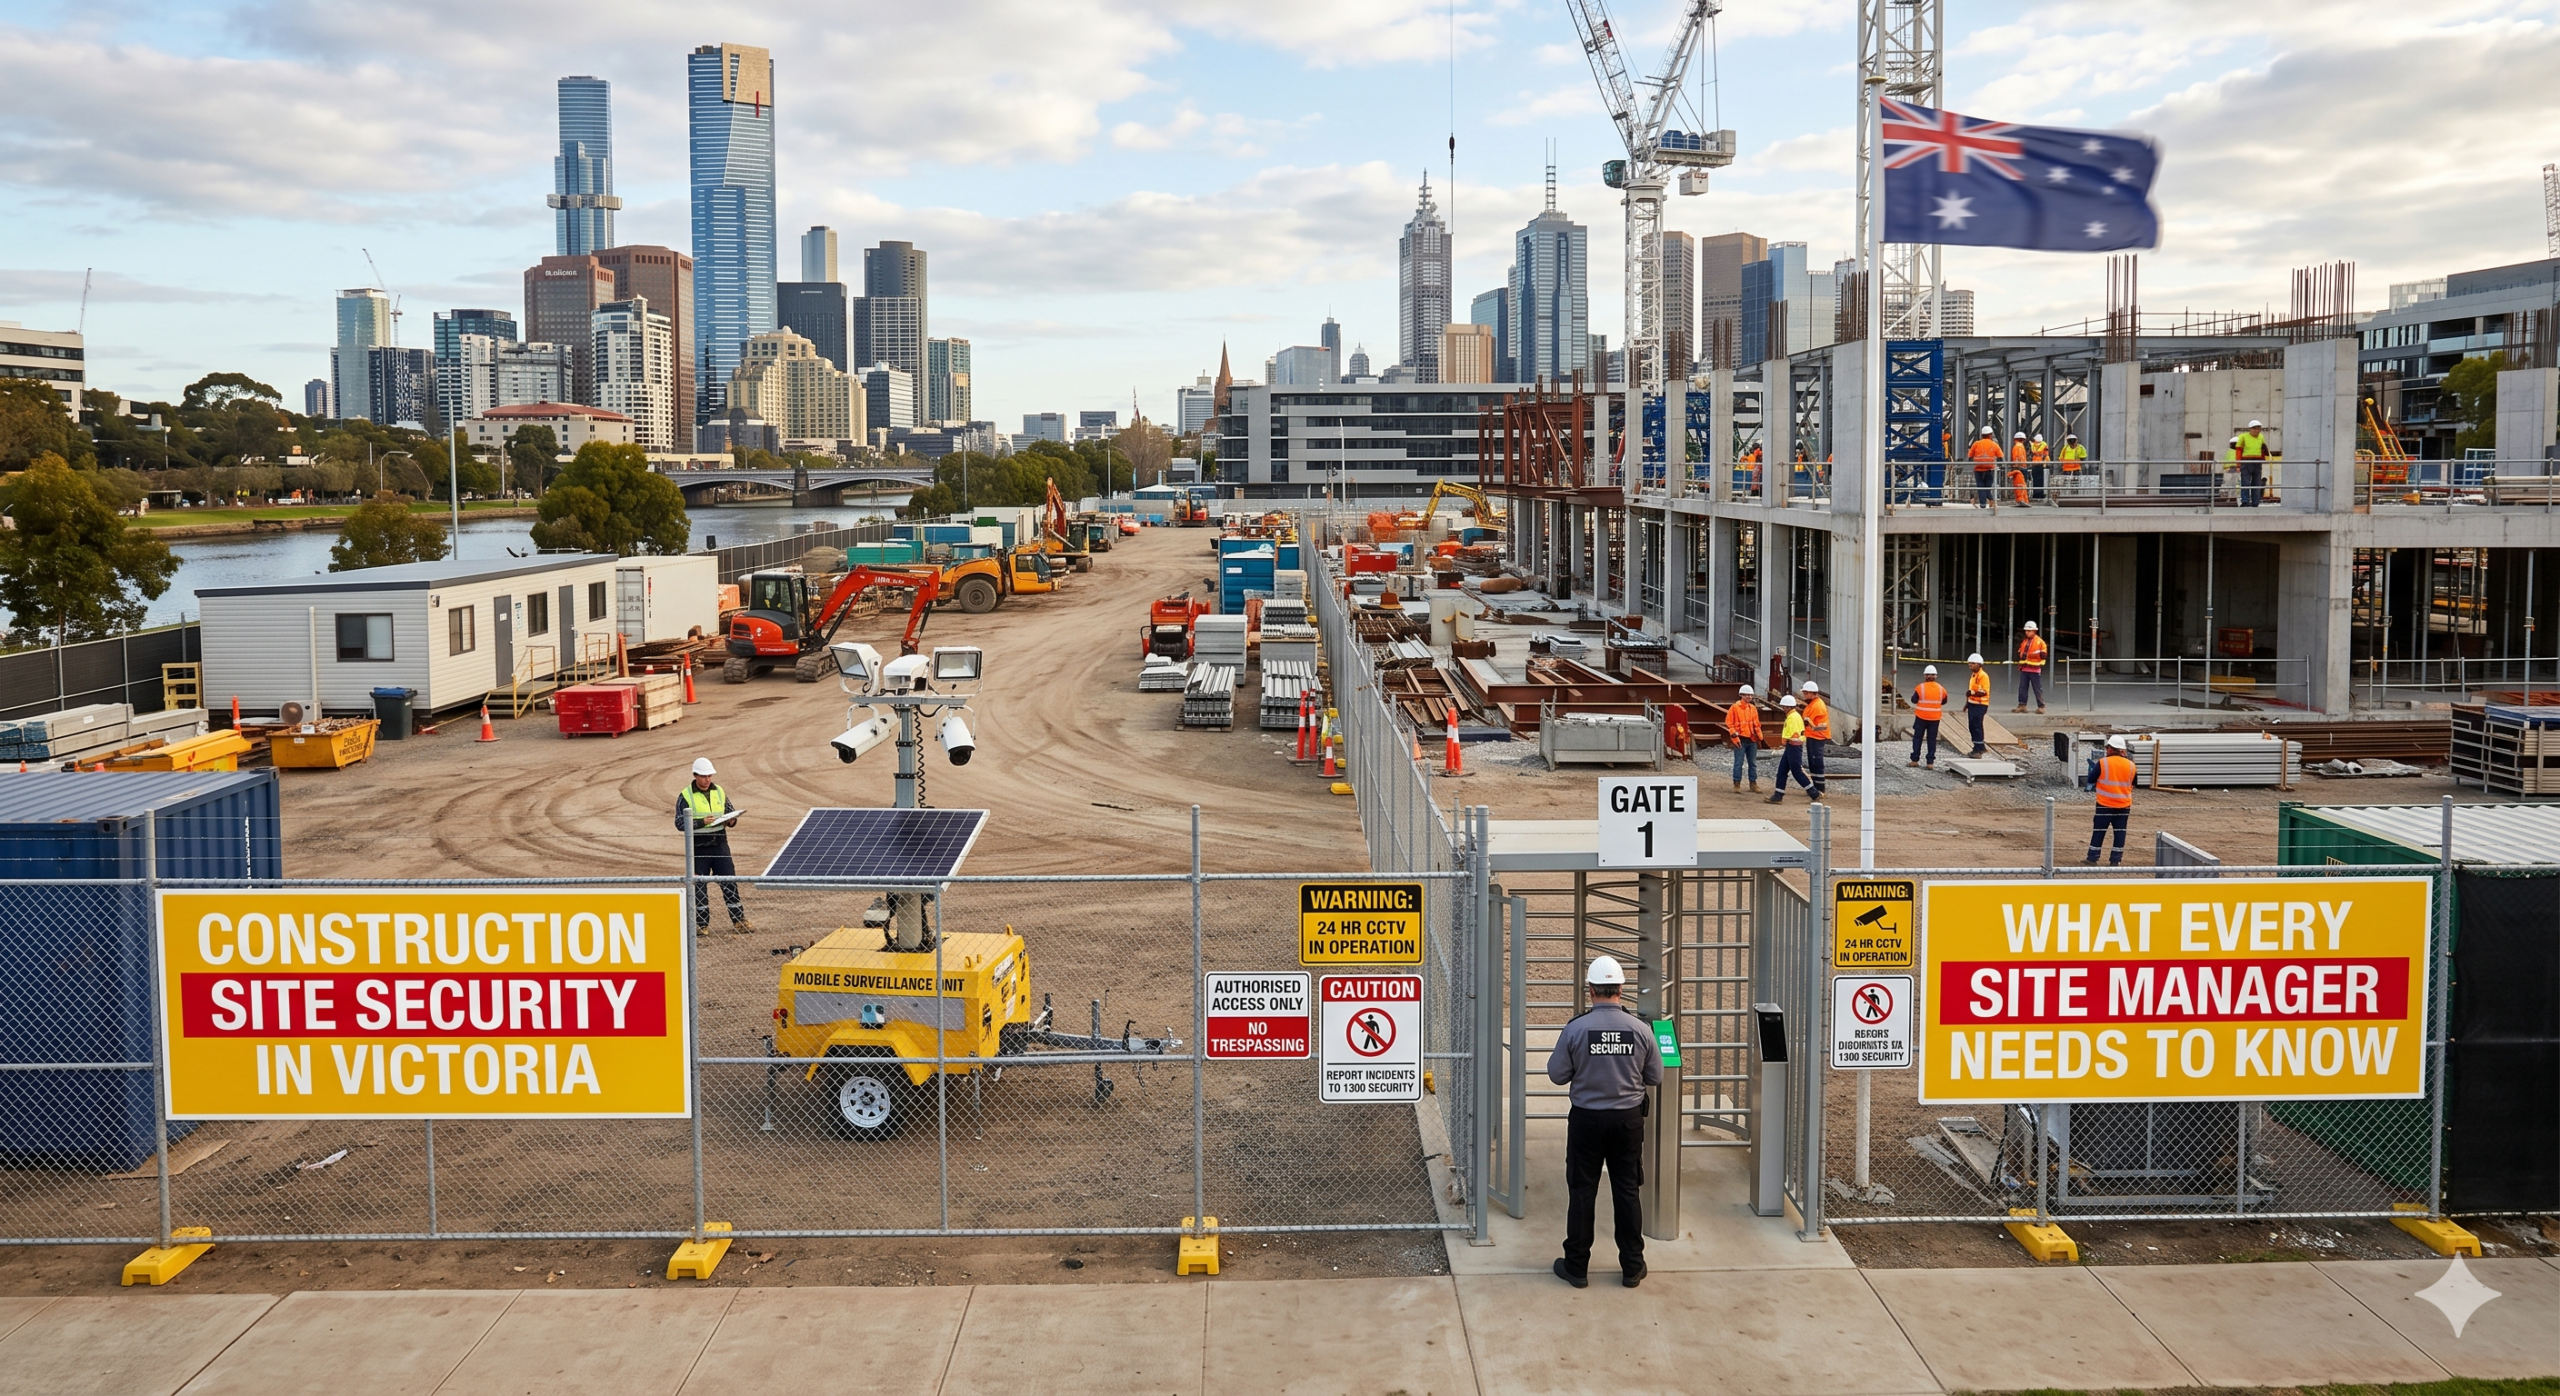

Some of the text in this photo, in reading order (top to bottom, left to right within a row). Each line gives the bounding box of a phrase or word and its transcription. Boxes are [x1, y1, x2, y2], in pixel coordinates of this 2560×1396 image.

[1611, 786, 1684, 813] GATE
[1637, 820, 1654, 859] 1
[1310, 889, 1413, 910] WARNING:
[1317, 920, 1406, 935] 24 HR CCTV
[2002, 902, 2352, 952] WHAT EVERY
[198, 912, 646, 965] CONSTRUCTION
[1844, 938, 1902, 949] 24 HR CCTV
[1309, 939, 1415, 955] IN OPERATION
[1839, 951, 1908, 962] IN OPERATION
[793, 972, 841, 987] MOBILE
[843, 974, 933, 991] SURVEILLANCE
[1214, 980, 1301, 994] AUTHORISED
[1329, 980, 1415, 999] CAUTION
[1970, 965, 2378, 1017] SITE MANAGER
[212, 979, 637, 1030] SITE SECURITY
[1211, 997, 1304, 1011] ACCESS ONLY
[1248, 1021, 1268, 1036] NO
[1601, 1031, 1621, 1043] SITE
[1210, 1038, 1305, 1052] TRESPASSING
[1590, 1043, 1634, 1055] SECURITY
[1838, 1051, 1904, 1062] 1300 SECURITY
[1951, 1027, 2398, 1079] NEEDS TO KNOW
[257, 1044, 601, 1095] IN VICTORIA
[1326, 1069, 1416, 1081] REPORT INCIDENTS
[1328, 1082, 1414, 1093] TO 1300 SECURITY
